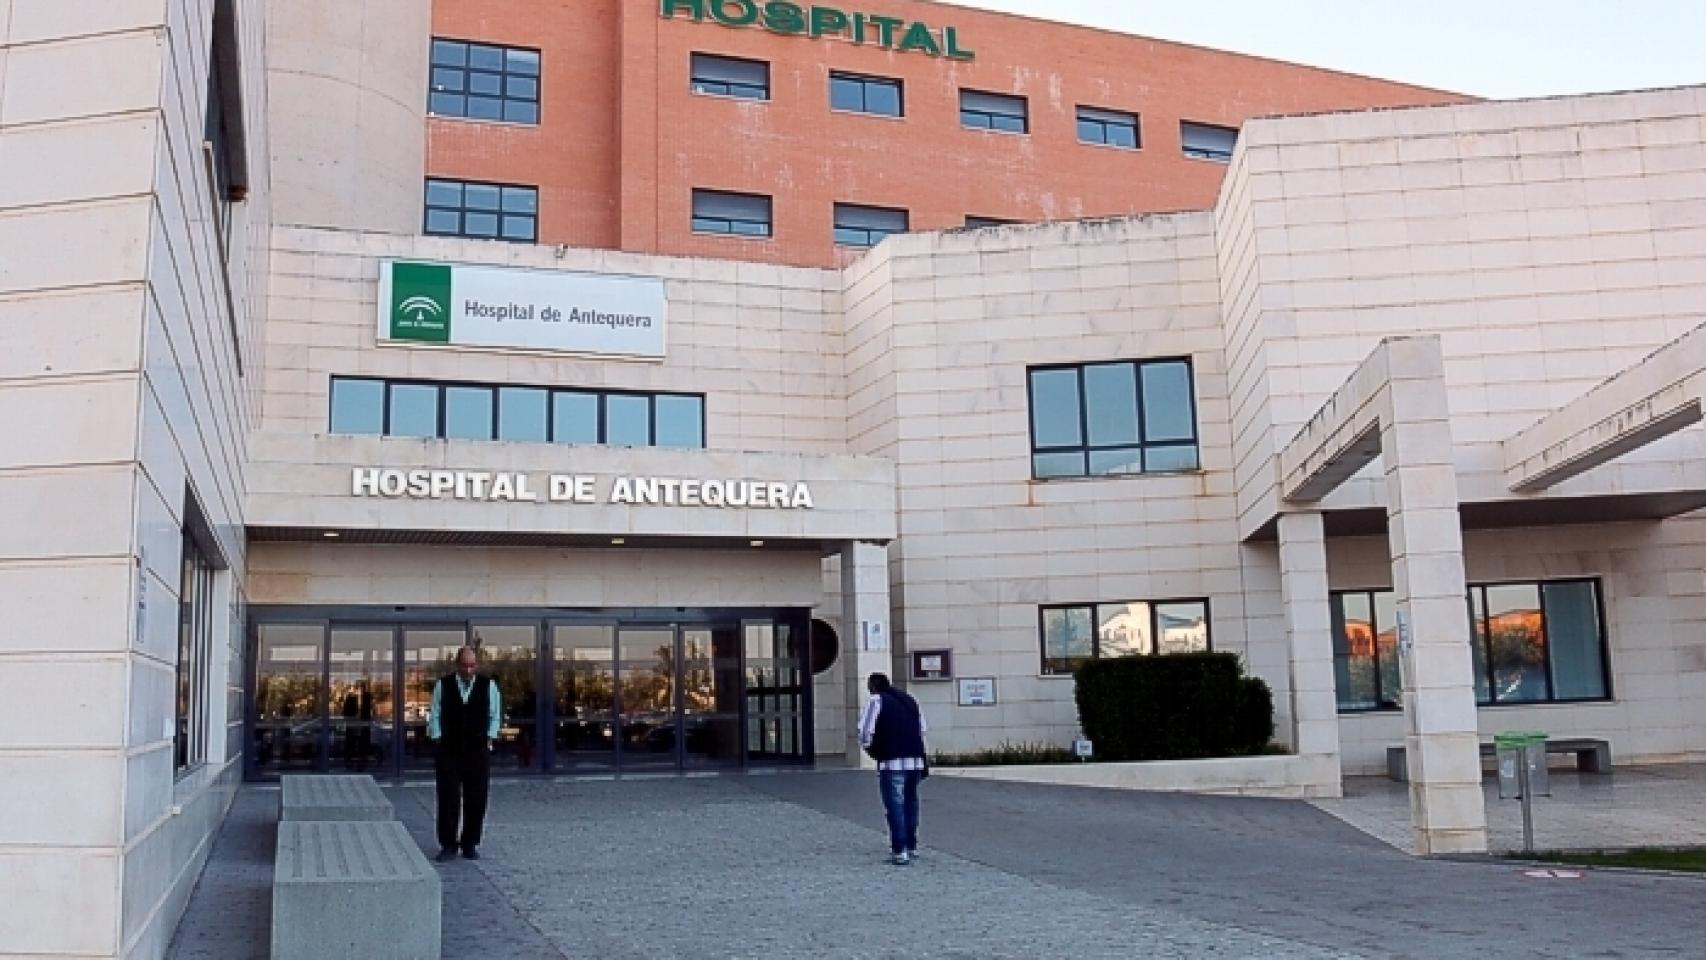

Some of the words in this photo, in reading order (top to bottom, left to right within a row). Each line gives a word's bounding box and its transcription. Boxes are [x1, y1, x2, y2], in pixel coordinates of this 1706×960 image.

[660, 0, 975, 59] HOSPITAL
[464, 299, 535, 322] Hospital
[540, 305, 563, 323] de
[568, 307, 652, 330] Antequera
[351, 467, 536, 502] HOSPITAL
[548, 474, 596, 502] DE
[610, 477, 814, 508] ANTEQUERA
